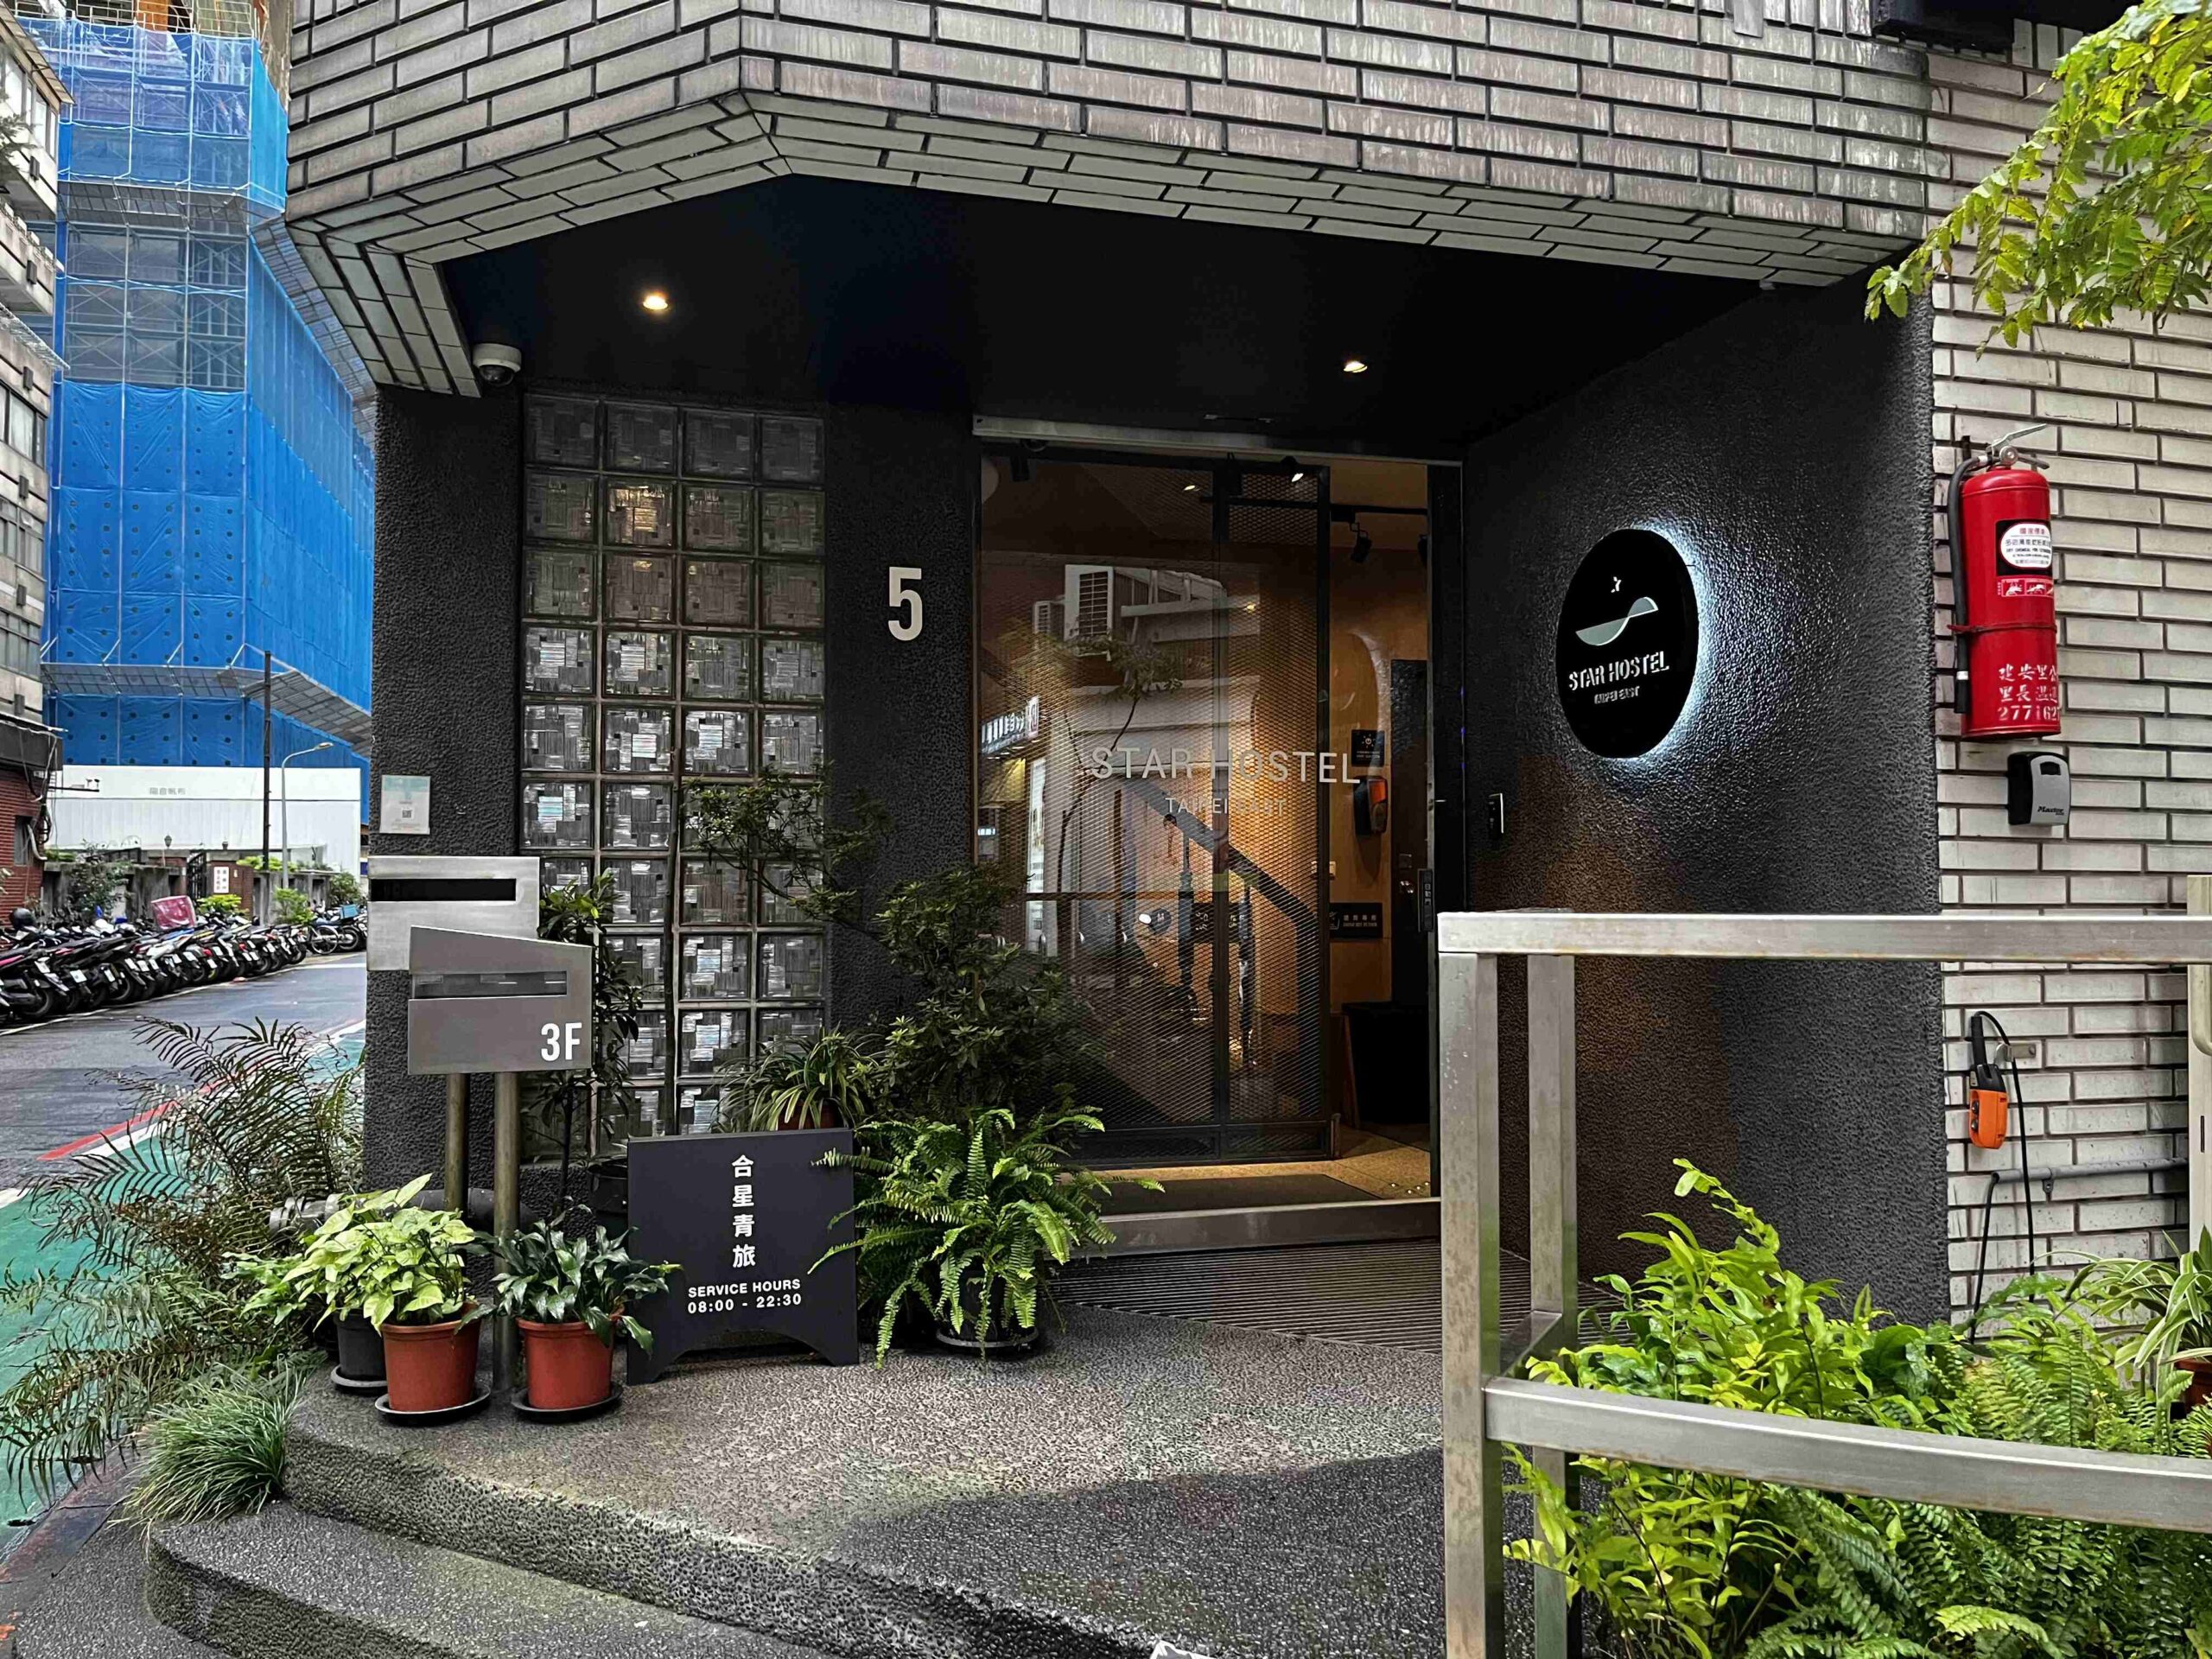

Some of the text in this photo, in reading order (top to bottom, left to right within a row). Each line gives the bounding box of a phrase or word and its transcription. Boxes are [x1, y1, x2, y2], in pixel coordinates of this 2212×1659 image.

[888, 567, 923, 641] 5
[1569, 652, 1669, 690] STAR HOSTEL
[1091, 747, 1361, 785] STAR HOSTEL
[541, 1022, 582, 1061] 3F
[732, 1154, 756, 1268] 合星青旅
[687, 1298, 734, 1314] 08:00
[756, 1294, 801, 1309] 22:30
[688, 1279, 800, 1298] SERVICE HOURS
